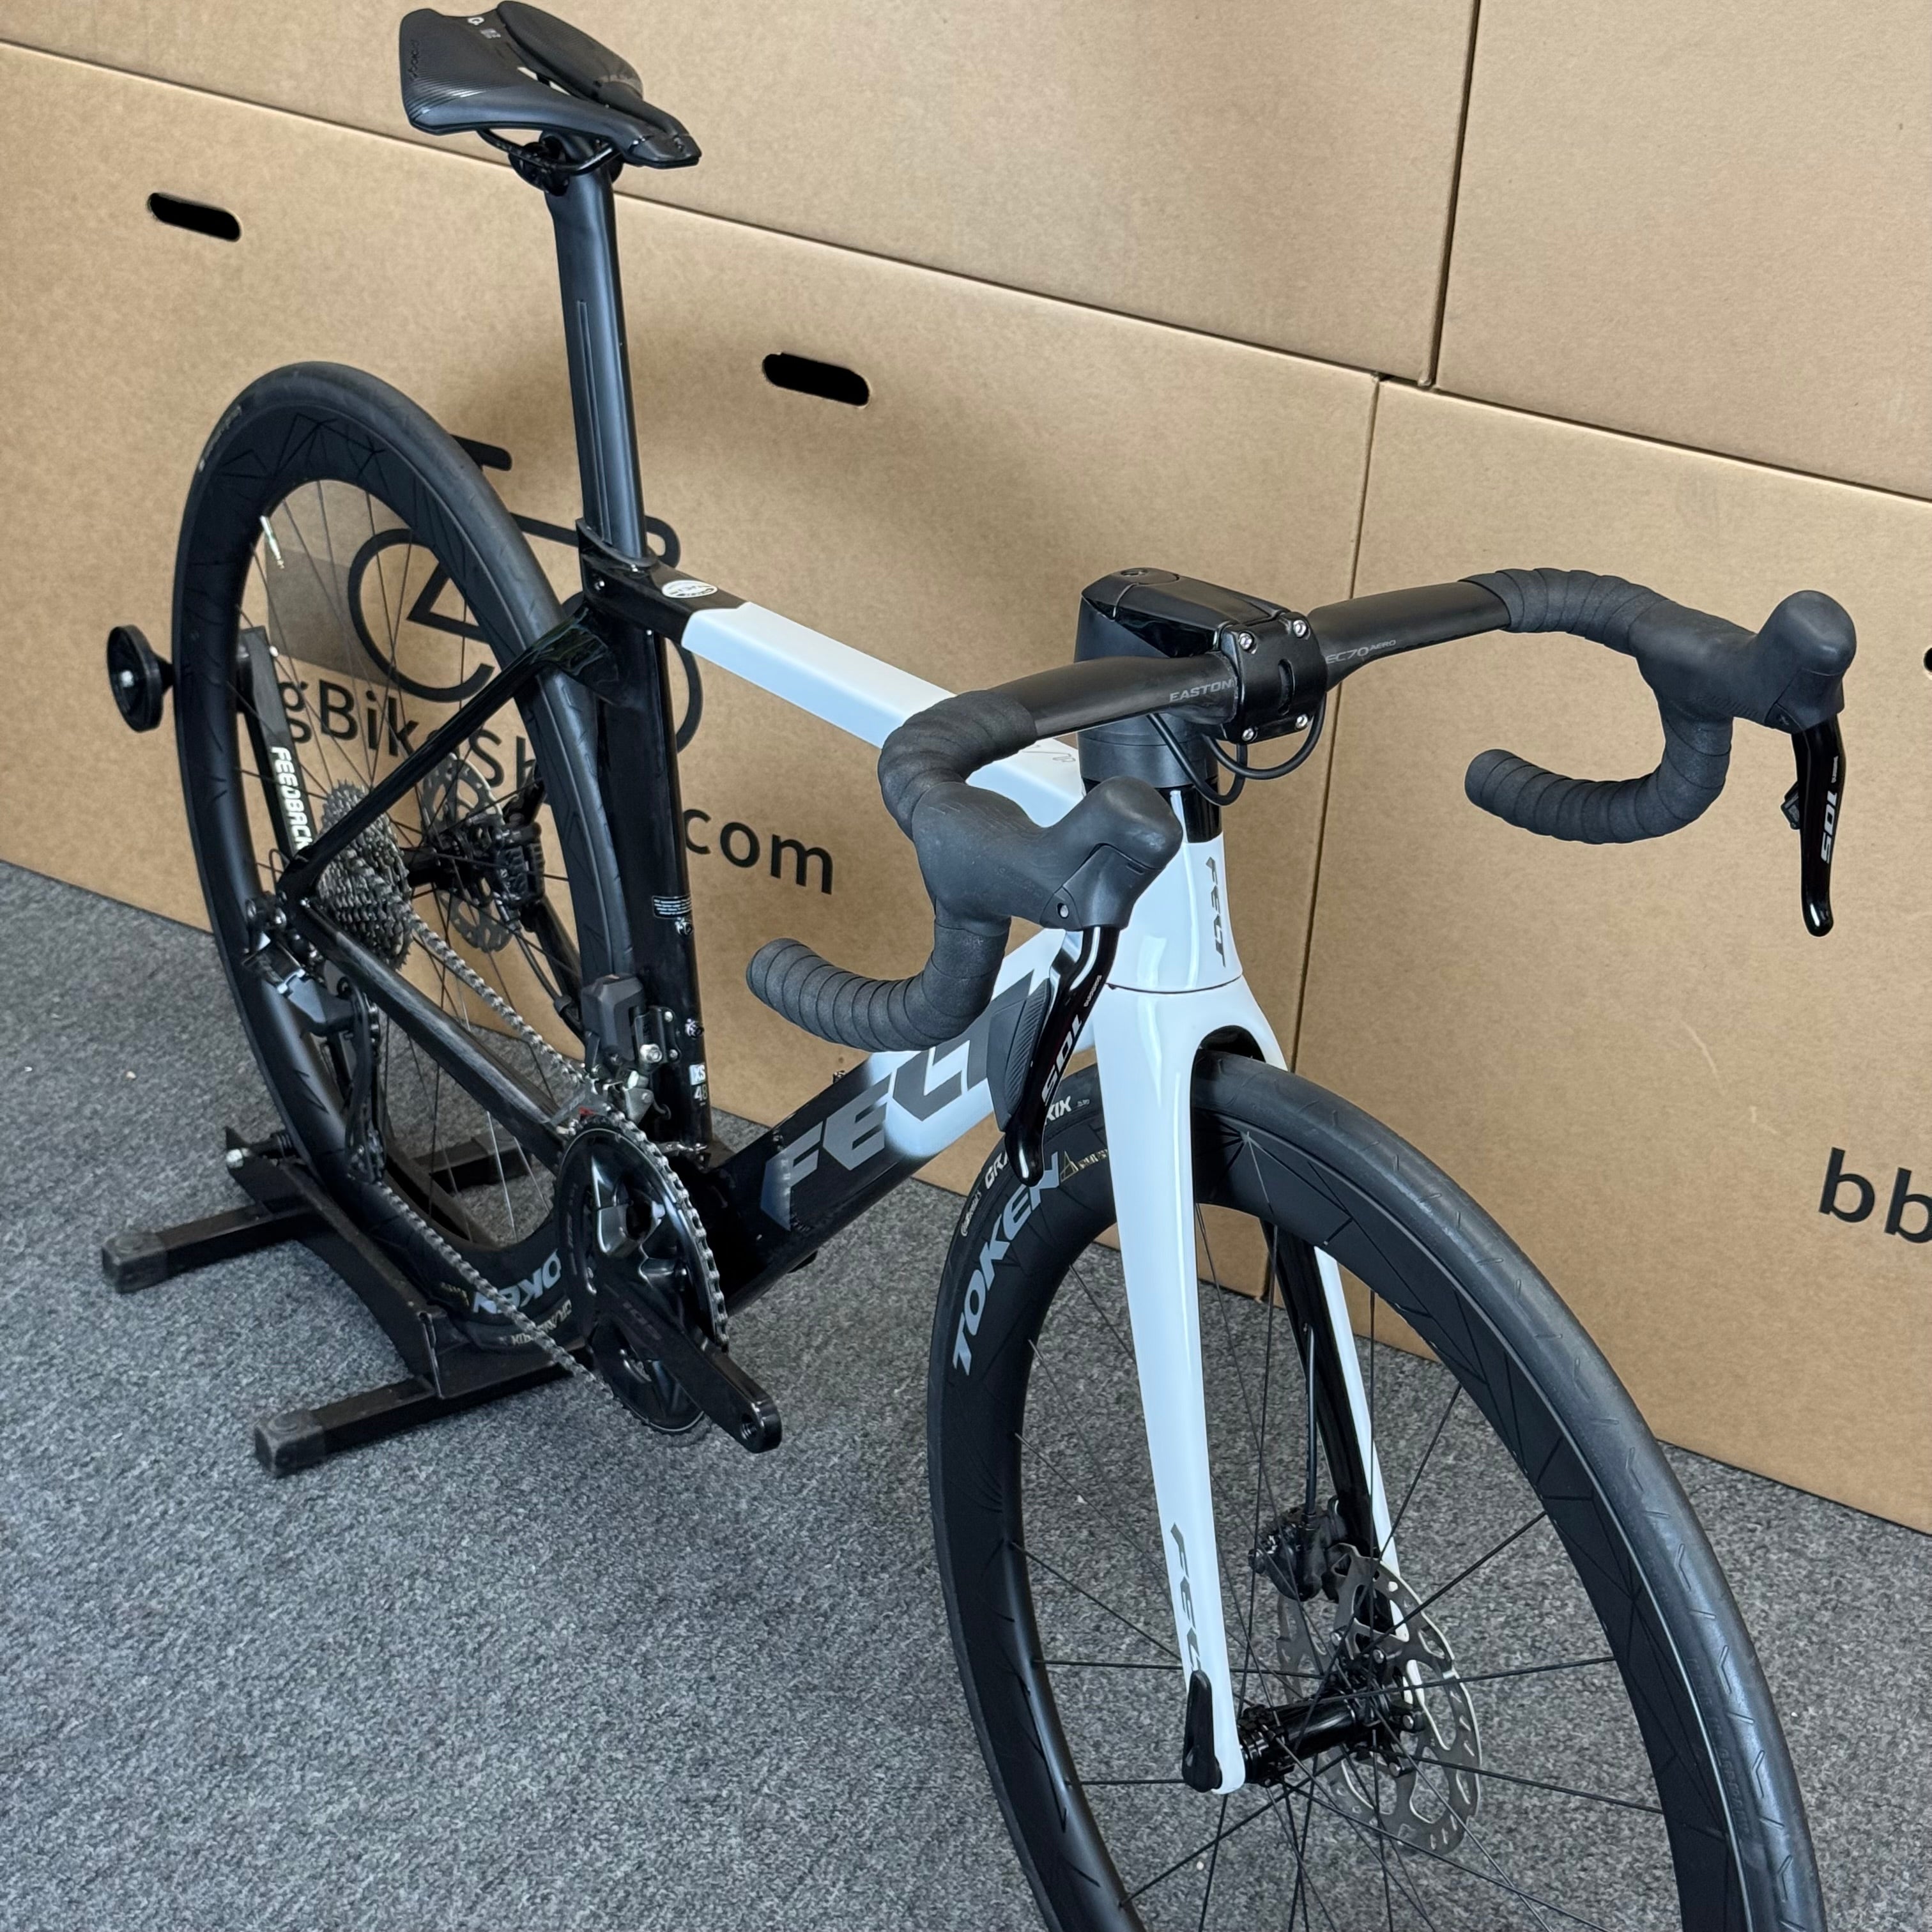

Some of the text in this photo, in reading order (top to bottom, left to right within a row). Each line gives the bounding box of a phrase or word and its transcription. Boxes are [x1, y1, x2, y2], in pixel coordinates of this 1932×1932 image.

[1169, 678, 1234, 703] EASTON
[1325, 639, 1397, 664] EC70 AERO
[271, 746, 313, 850] FEEDBACK
[1820, 790, 1838, 864] 105
[1205, 855, 1227, 969] FELT
[694, 1084, 708, 1101] 48
[1041, 1013, 1082, 1107] 105
[1818, 1146, 1932, 1244] bb
[1170, 1521, 1202, 1671] FEL
